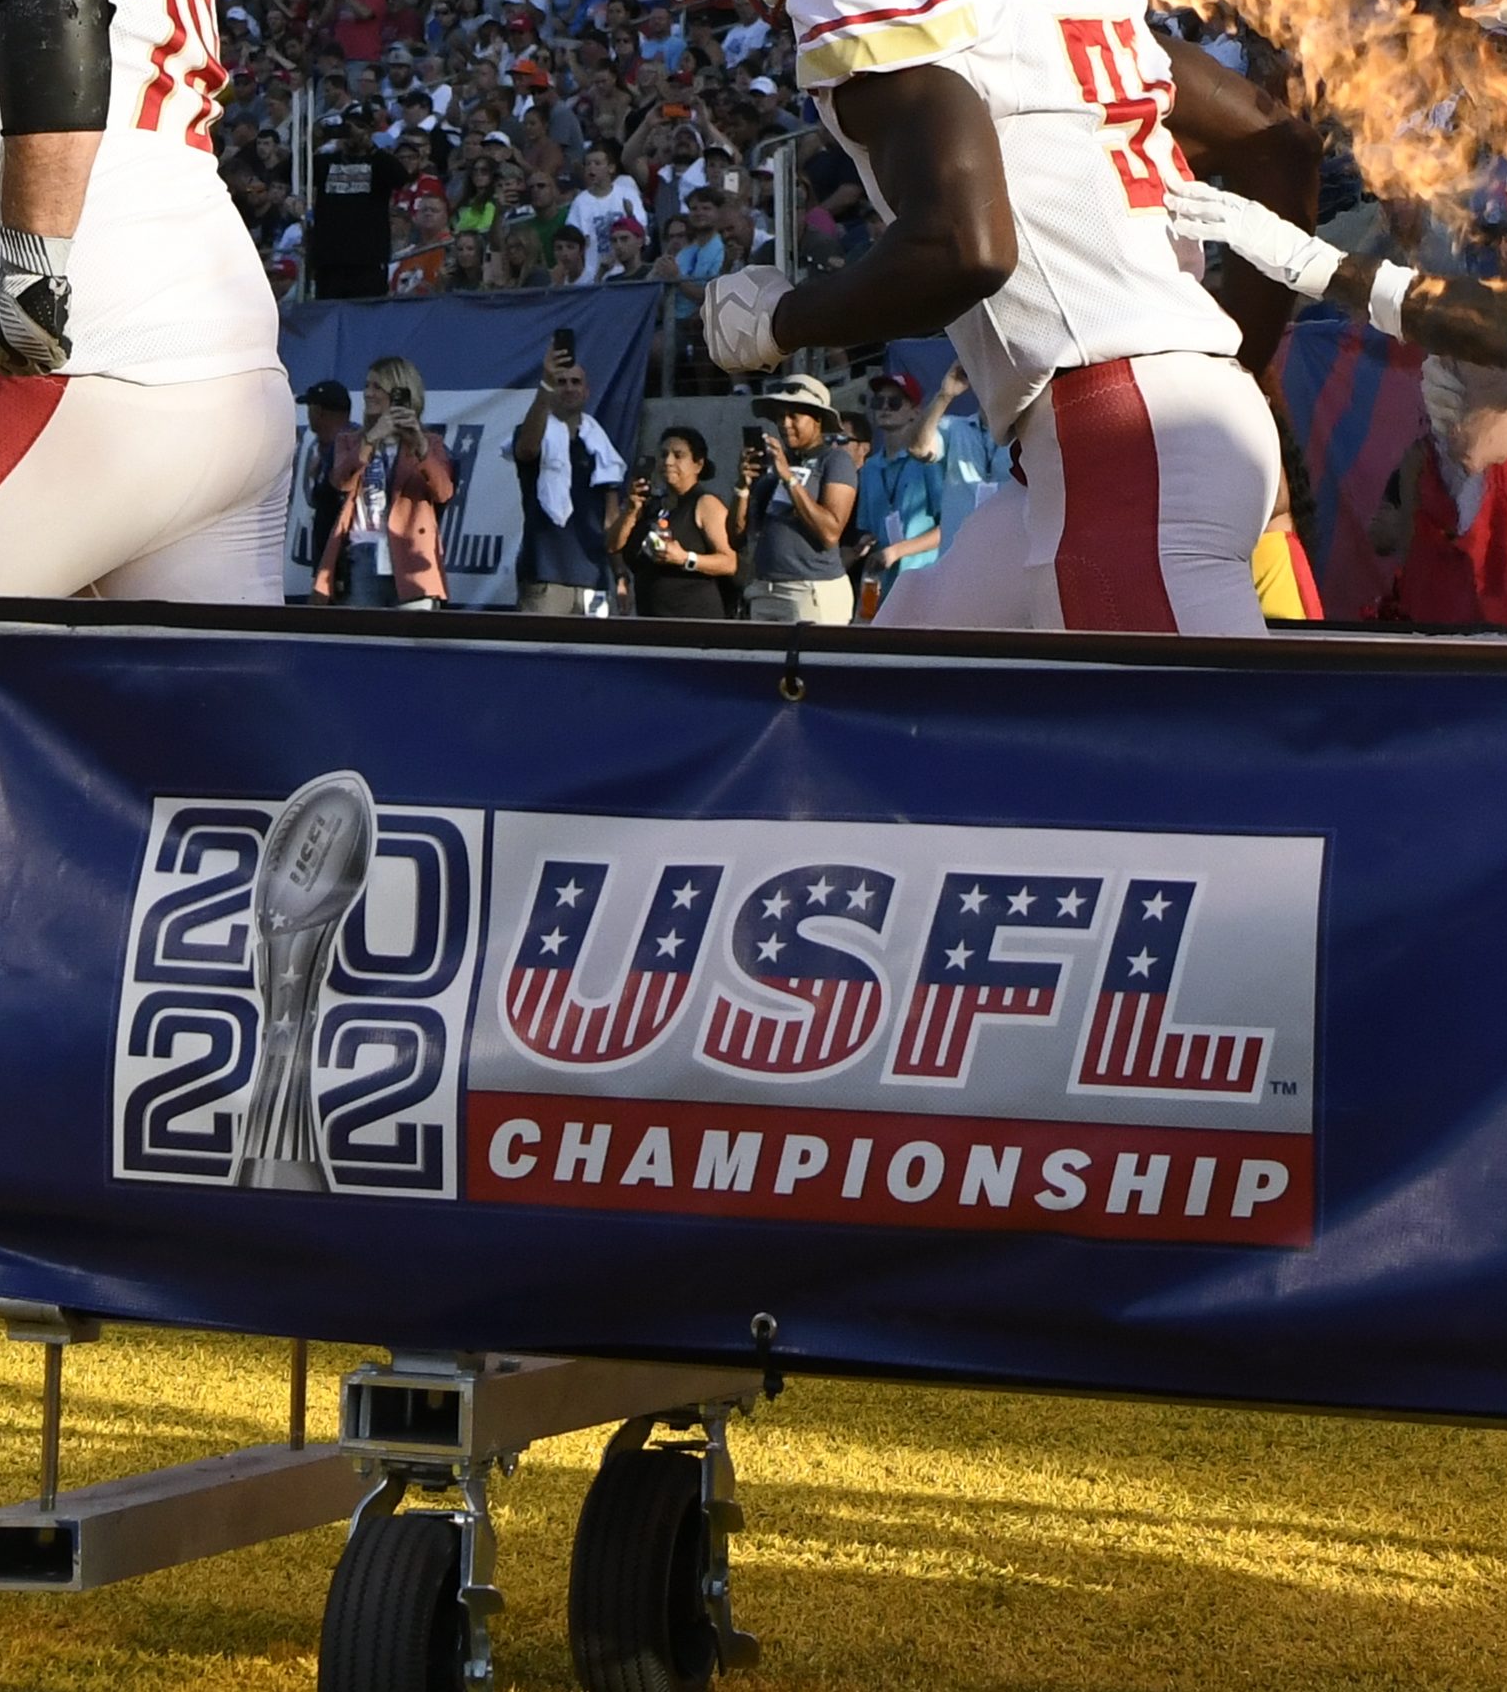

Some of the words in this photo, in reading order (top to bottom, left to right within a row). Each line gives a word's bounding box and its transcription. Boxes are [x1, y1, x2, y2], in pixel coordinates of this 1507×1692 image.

[133, 807, 471, 999] 20
[500, 857, 1269, 1098] USFL
[123, 990, 447, 1191] 22
[488, 1116, 1290, 1219] CHAMPIONSHIP
[1270, 1080, 1298, 1096] TM
